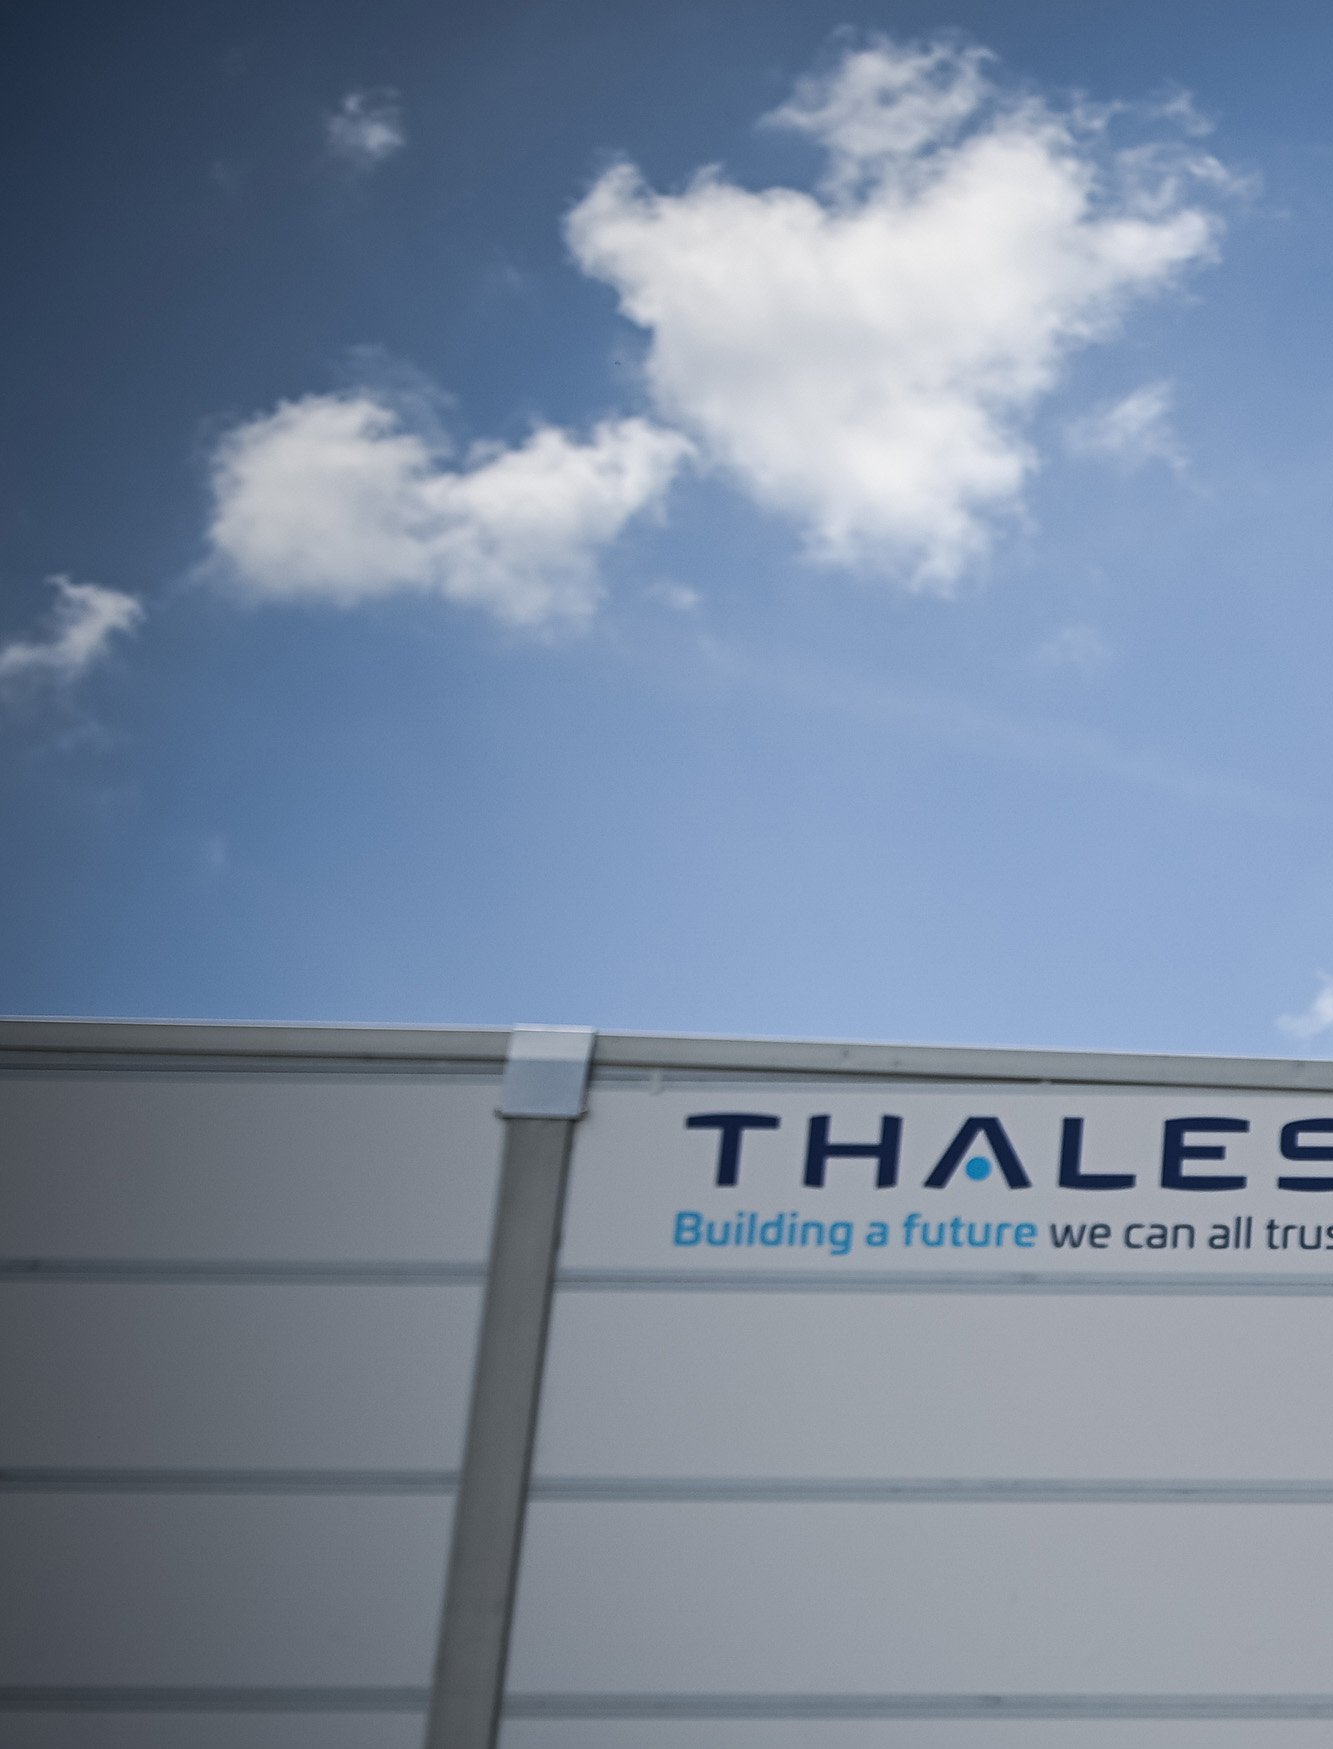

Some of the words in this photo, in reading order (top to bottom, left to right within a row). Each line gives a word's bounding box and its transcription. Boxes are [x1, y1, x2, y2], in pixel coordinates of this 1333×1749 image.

[672, 1210, 853, 1255] Building
[865, 1221, 890, 1248] a
[902, 1212, 1037, 1247] future
[1049, 1223, 1111, 1248] we
[1123, 1223, 1195, 1249] can
[1207, 1215, 1252, 1249] all
